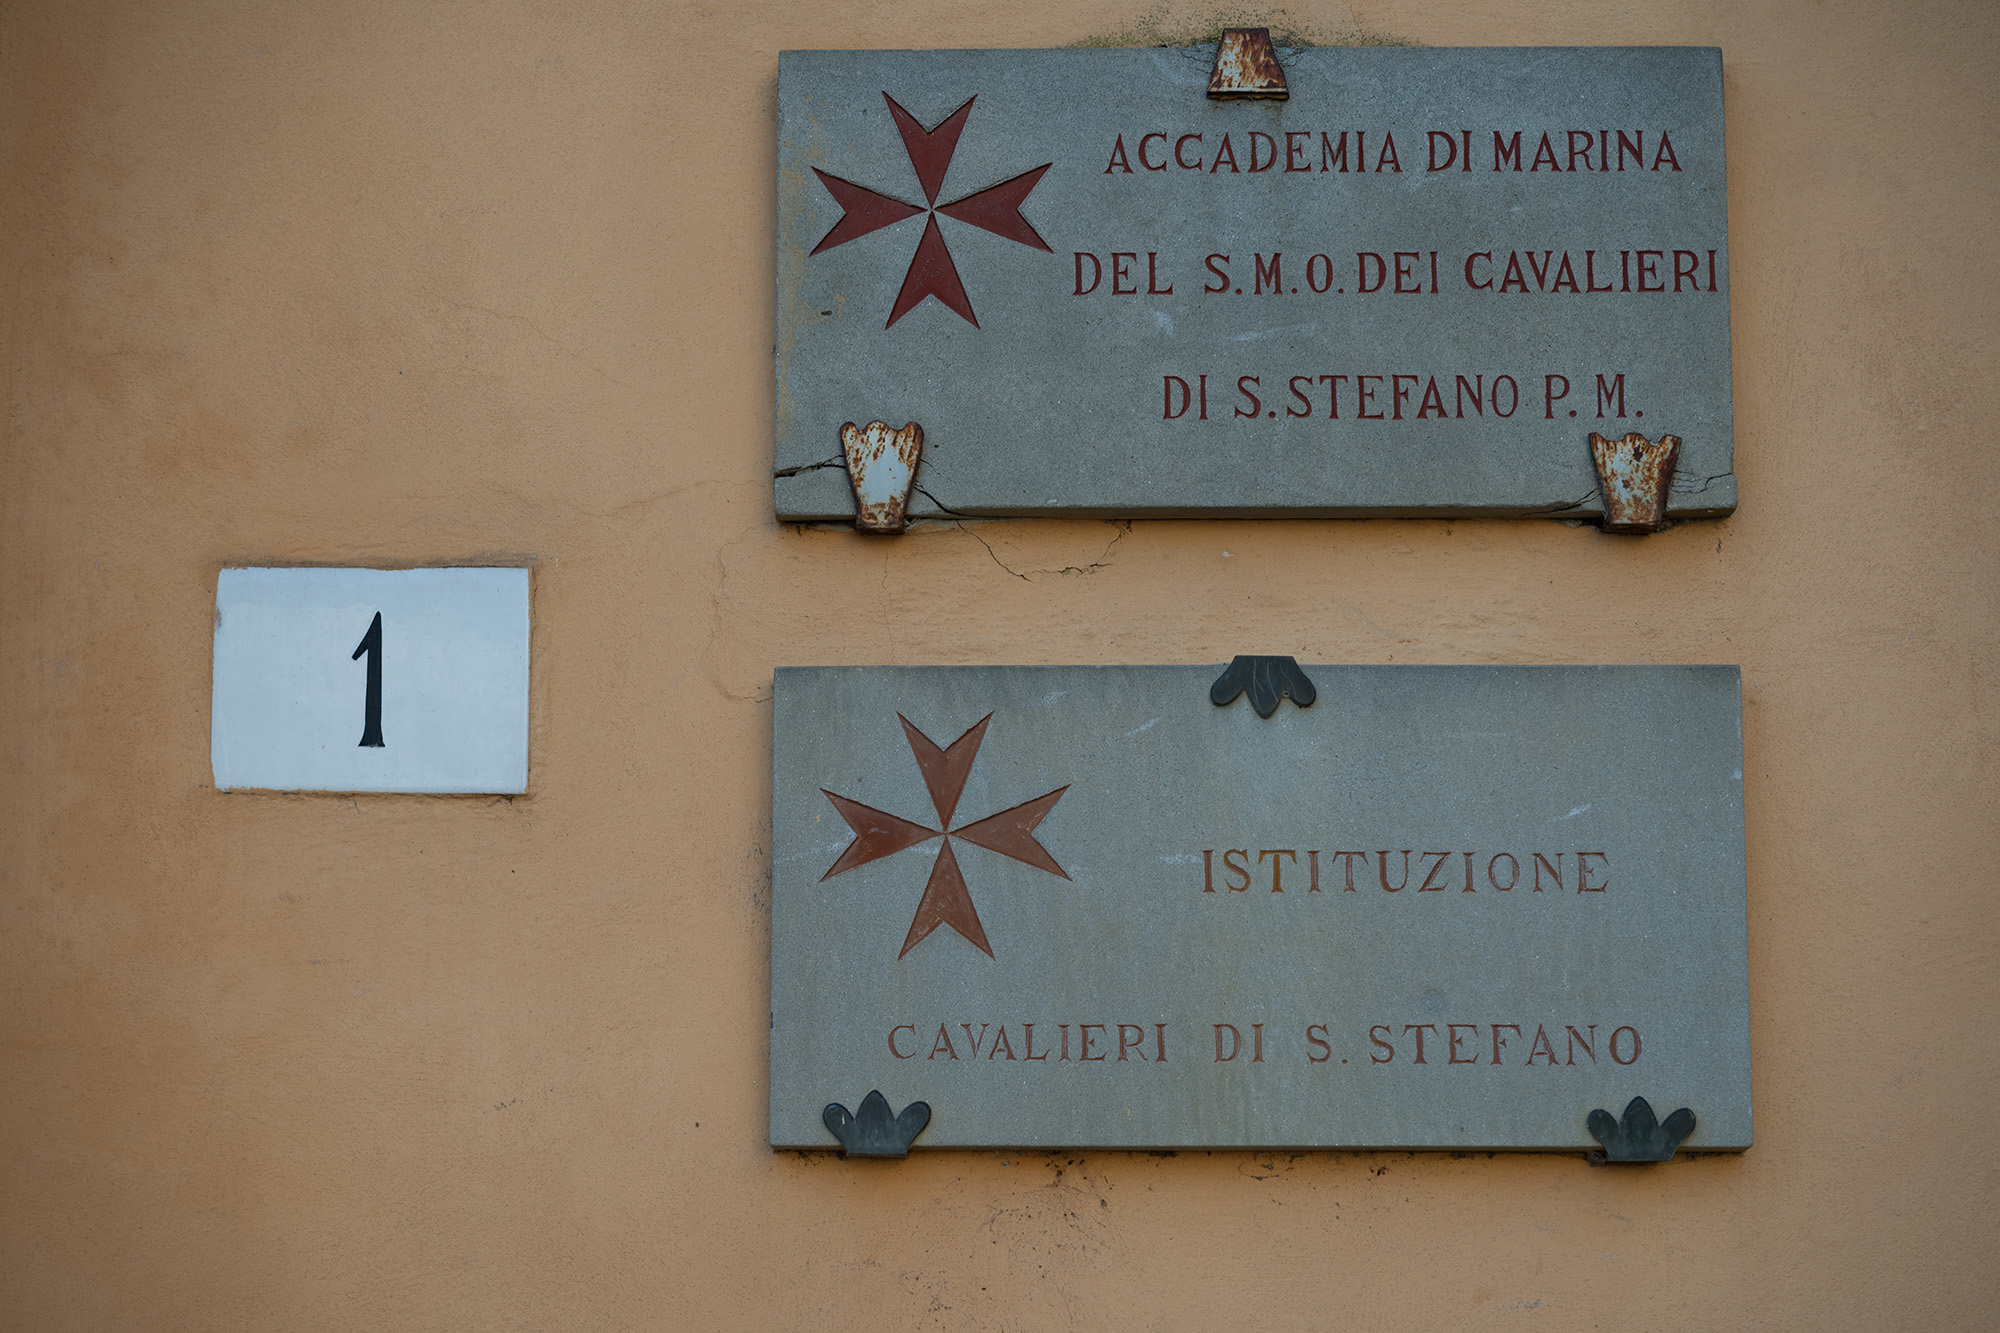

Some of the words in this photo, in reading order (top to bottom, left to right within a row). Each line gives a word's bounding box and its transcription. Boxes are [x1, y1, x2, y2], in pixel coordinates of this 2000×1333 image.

[1104, 130, 1404, 176] ACCADEMIA
[1426, 130, 1475, 174] DI
[1493, 130, 1684, 174] MARINA
[1072, 252, 1175, 297] DEL
[1464, 249, 1720, 296] CAVALIERI
[1162, 374, 1210, 422] DI
[351, 610, 386, 748] 1
[1203, 848, 1611, 895] ISTITUZIONE
[887, 1023, 1169, 1063] CAVALIERI
[1212, 1023, 1265, 1065] DI
[1305, 1024, 1350, 1066] S.
[1368, 1025, 1644, 1068] STEFANO
